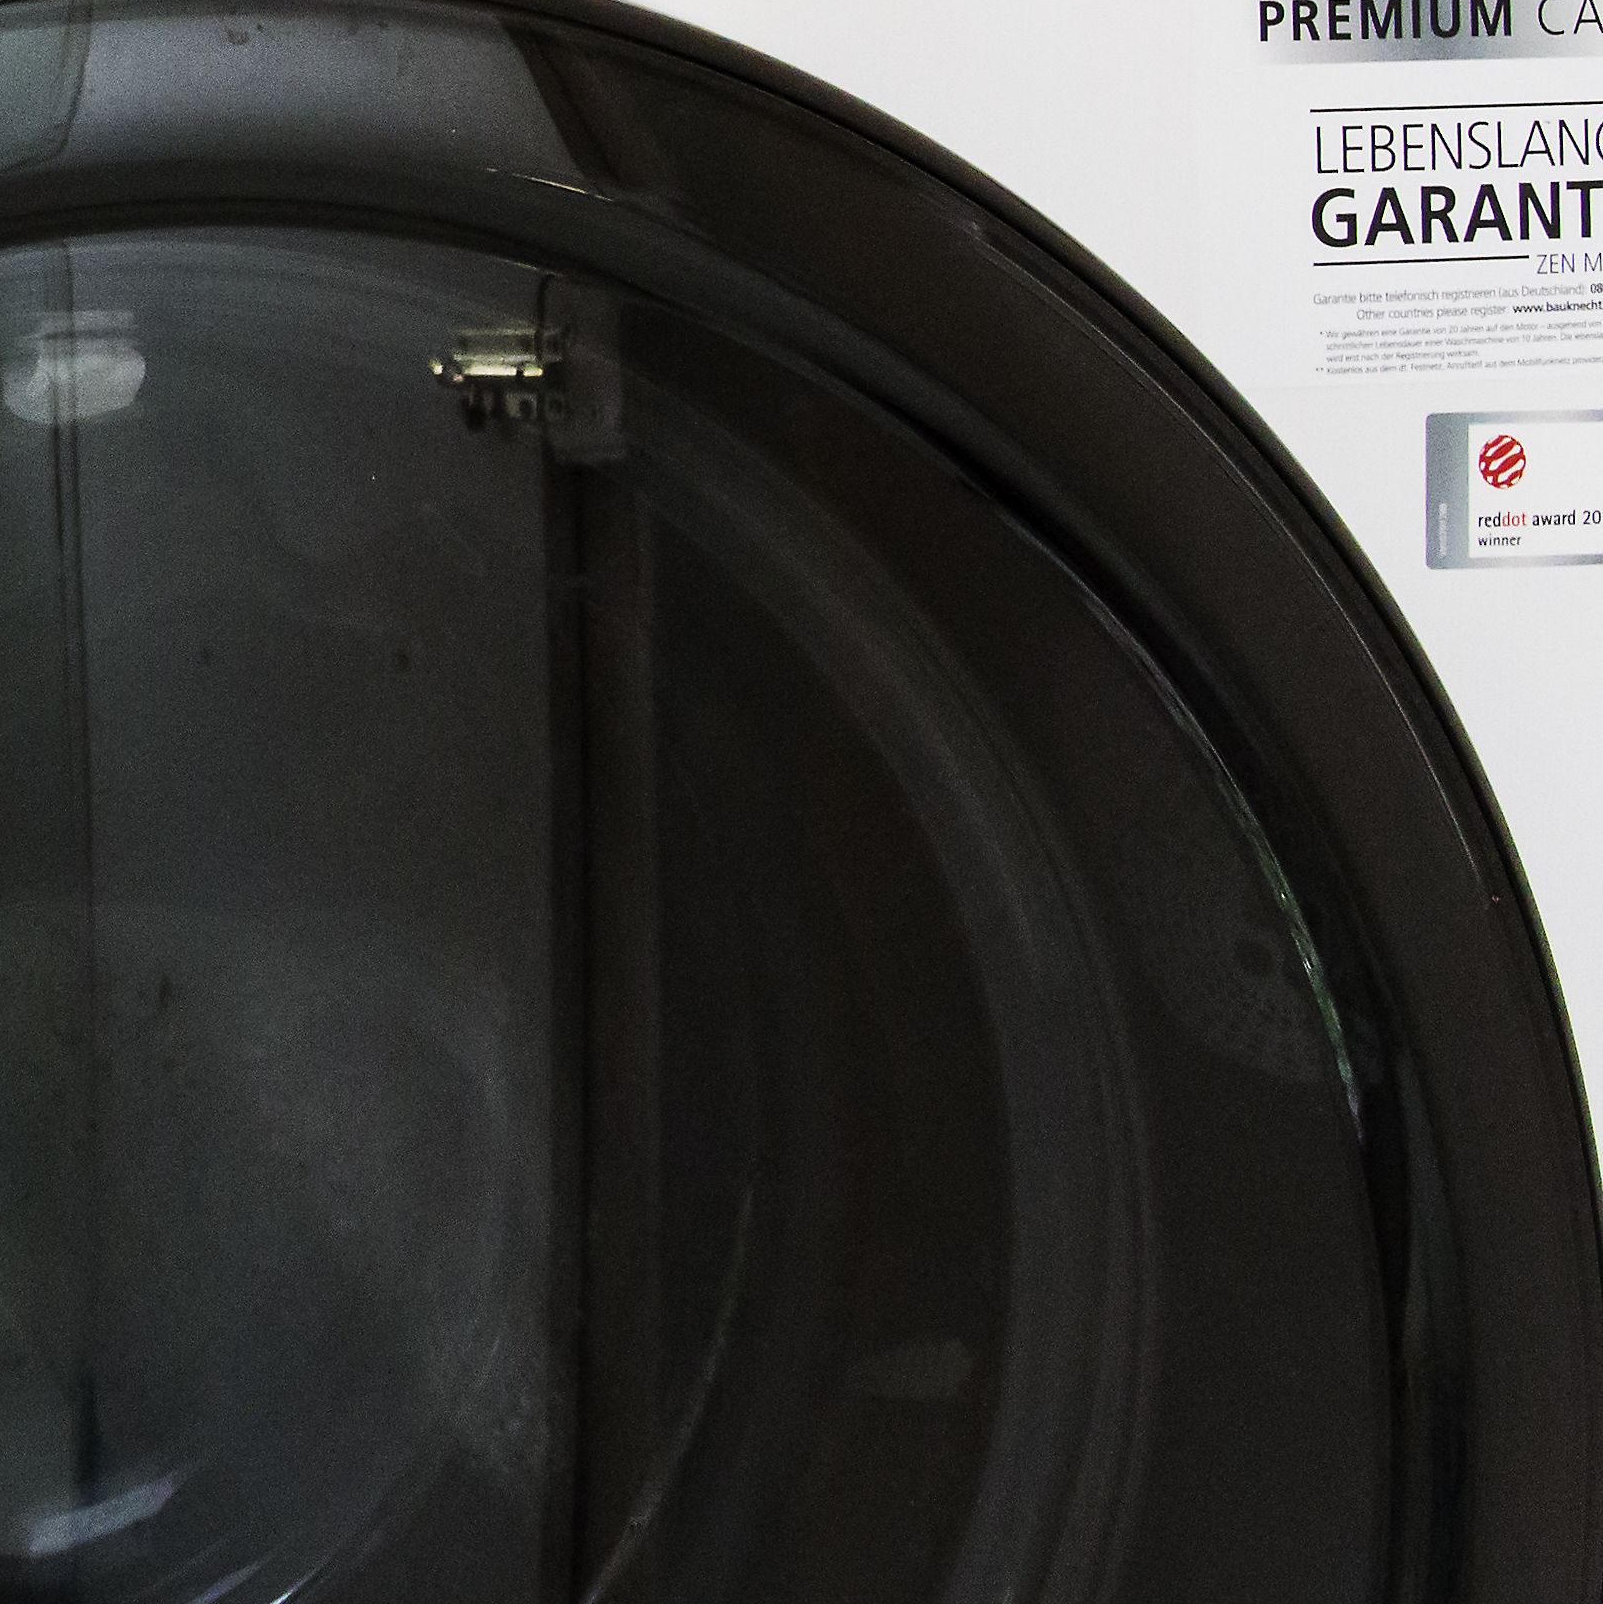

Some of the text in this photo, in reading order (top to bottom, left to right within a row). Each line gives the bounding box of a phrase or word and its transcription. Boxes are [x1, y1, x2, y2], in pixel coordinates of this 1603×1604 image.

[1316, 118, 1603, 174] LEBENSLAN
[1312, 180, 1603, 248] GARANT
[1536, 252, 1603, 274] ZEN M
[1359, 292, 1382, 303] bitte
[1356, 309, 1385, 320] Other
[1436, 306, 1467, 319] please
[1478, 509, 1602, 528] reddot award 20
[1478, 533, 1522, 546] winner
